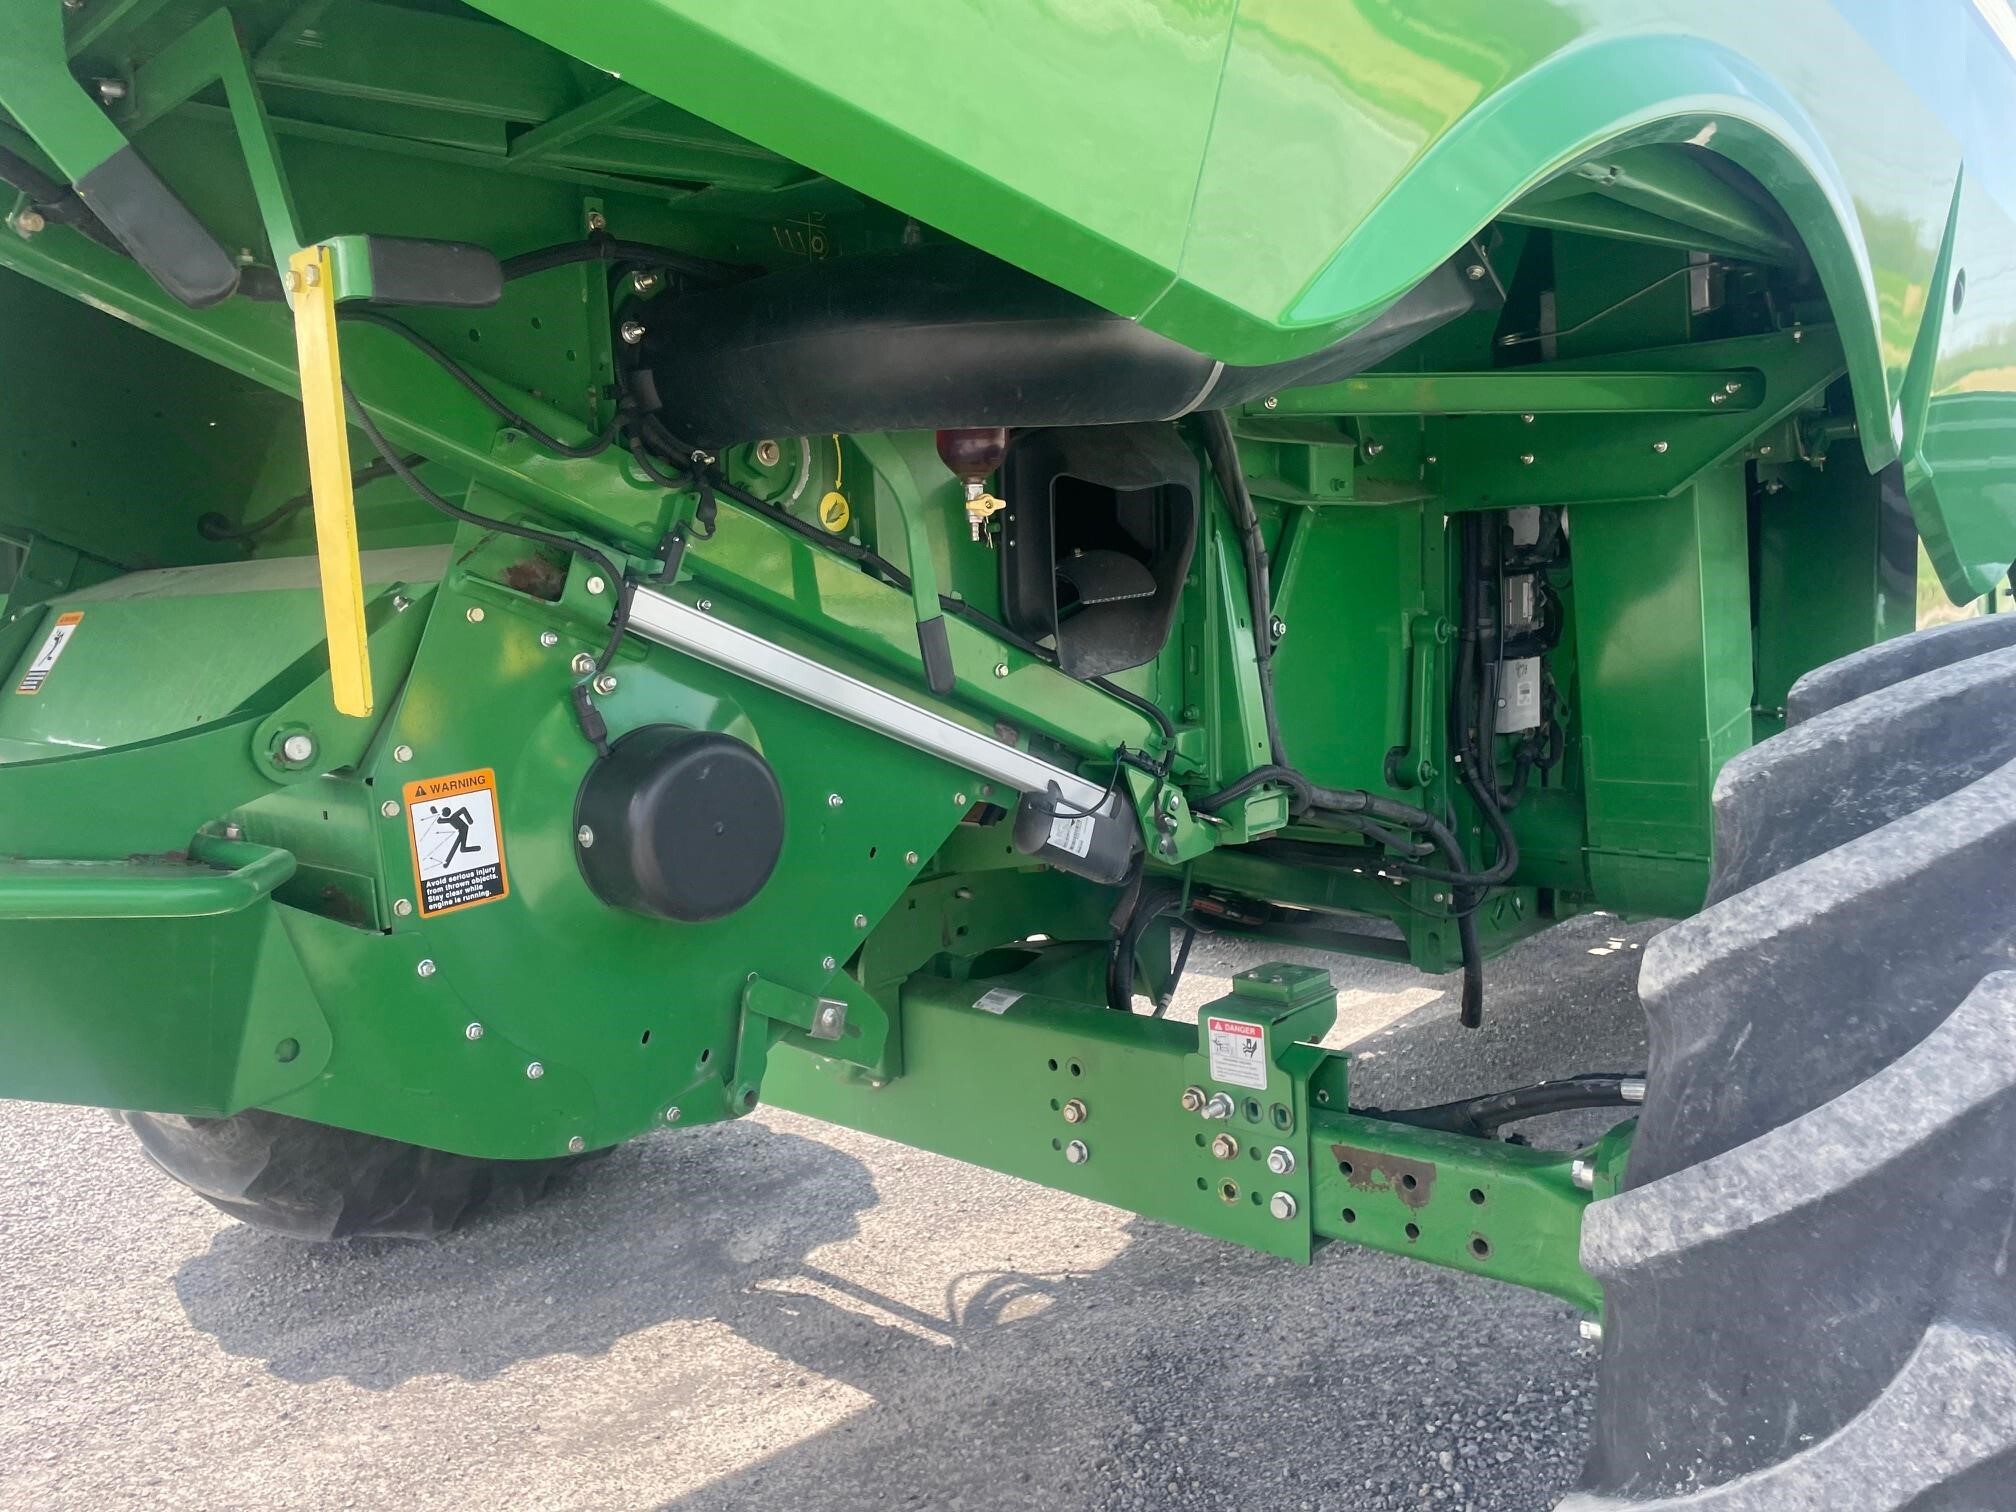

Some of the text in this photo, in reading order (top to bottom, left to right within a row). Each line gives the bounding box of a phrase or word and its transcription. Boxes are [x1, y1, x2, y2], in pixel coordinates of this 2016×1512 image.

[430, 775, 486, 794] WARNING
[426, 866, 496, 888] Avoid serious injury
[426, 873, 499, 895] from thrown objects.
[427, 884, 484, 903] Stay clear while
[428, 899, 453, 910] engine
[462, 890, 492, 901] running.
[1224, 1023, 1256, 1036] DANGER
